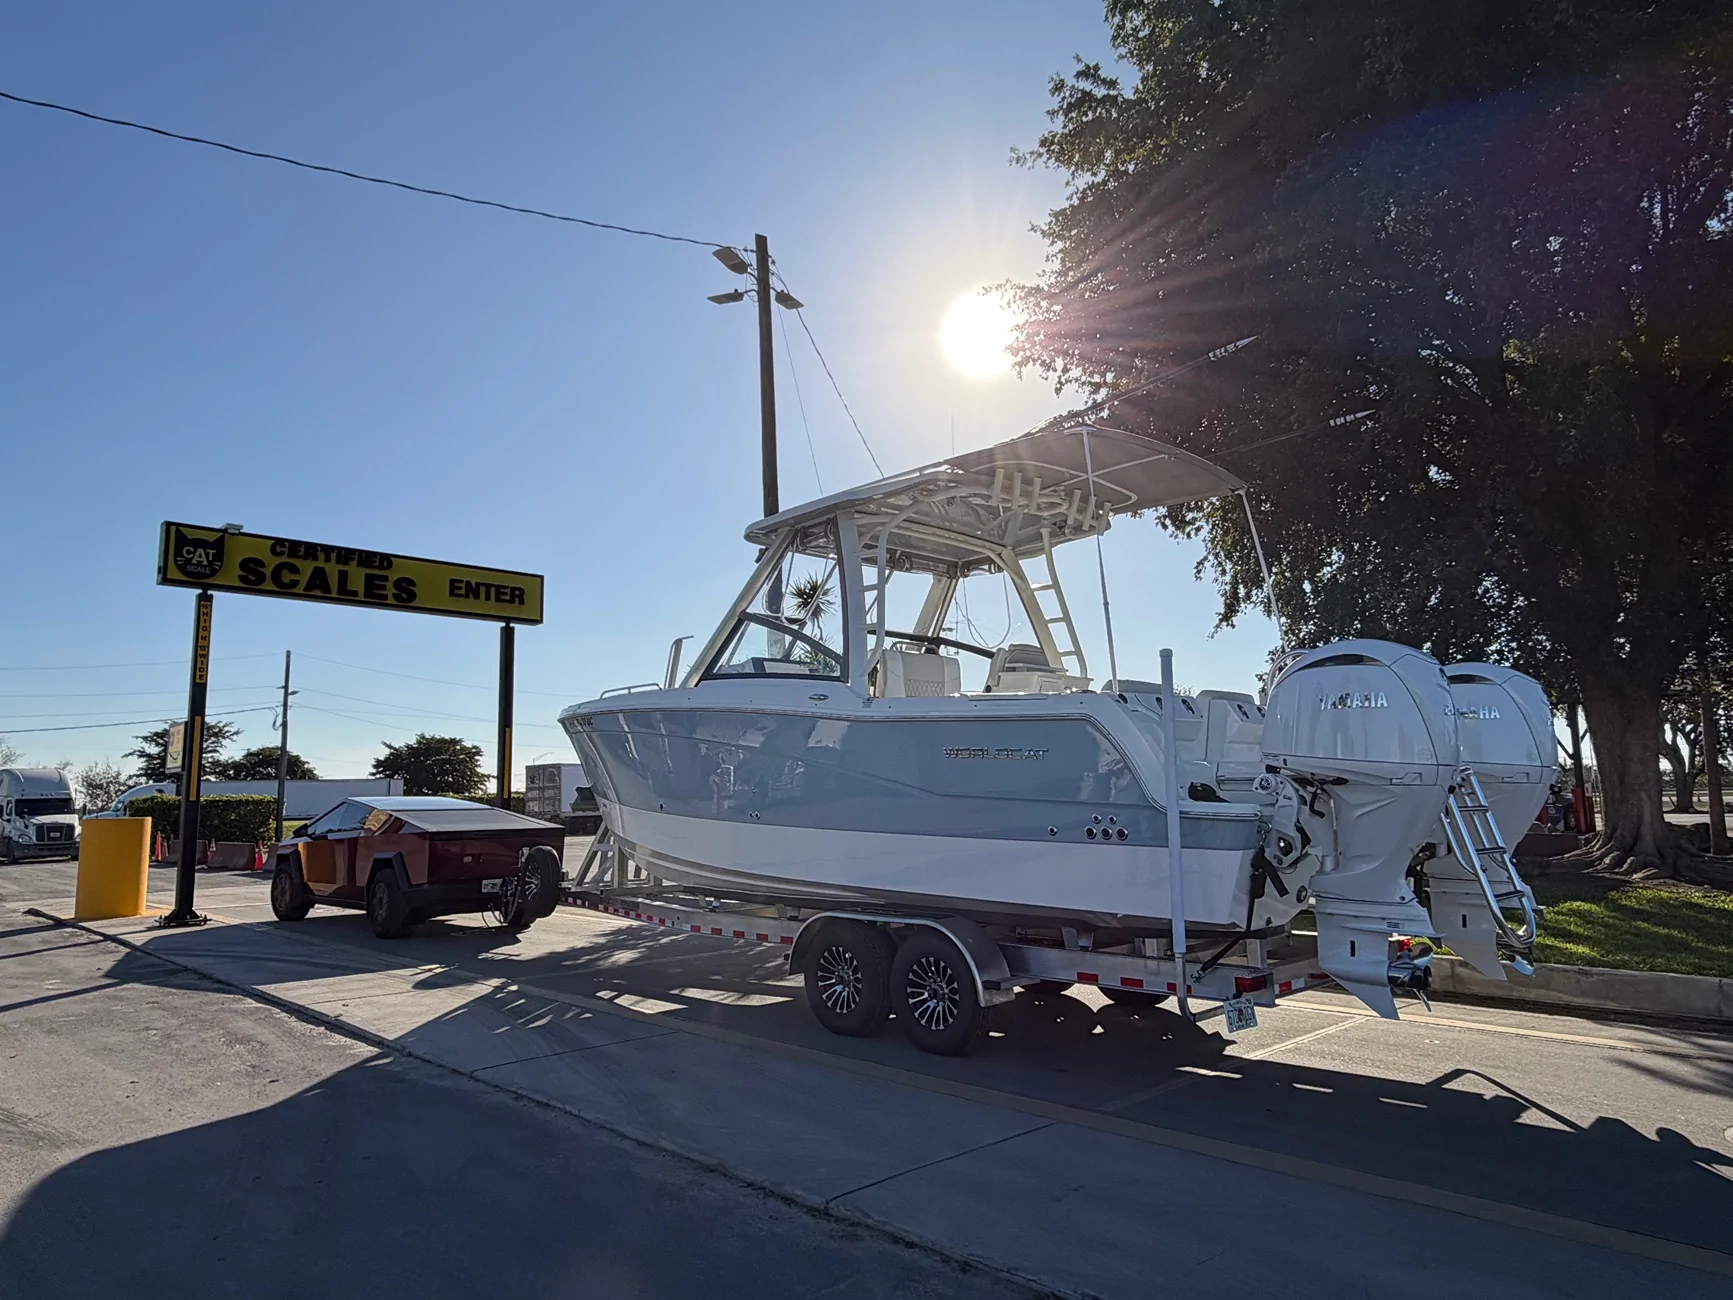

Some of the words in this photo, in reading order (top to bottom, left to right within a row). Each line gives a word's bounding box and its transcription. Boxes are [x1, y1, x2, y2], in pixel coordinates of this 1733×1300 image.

[182, 546, 217, 566] CAT
[186, 564, 212, 574] SCALE
[270, 539, 394, 571] CERTIFIED
[237, 556, 418, 604] SCALES
[448, 577, 526, 606] ENTER
[198, 653, 207, 681] WIDE
[1319, 691, 1389, 710] YAMAHA
